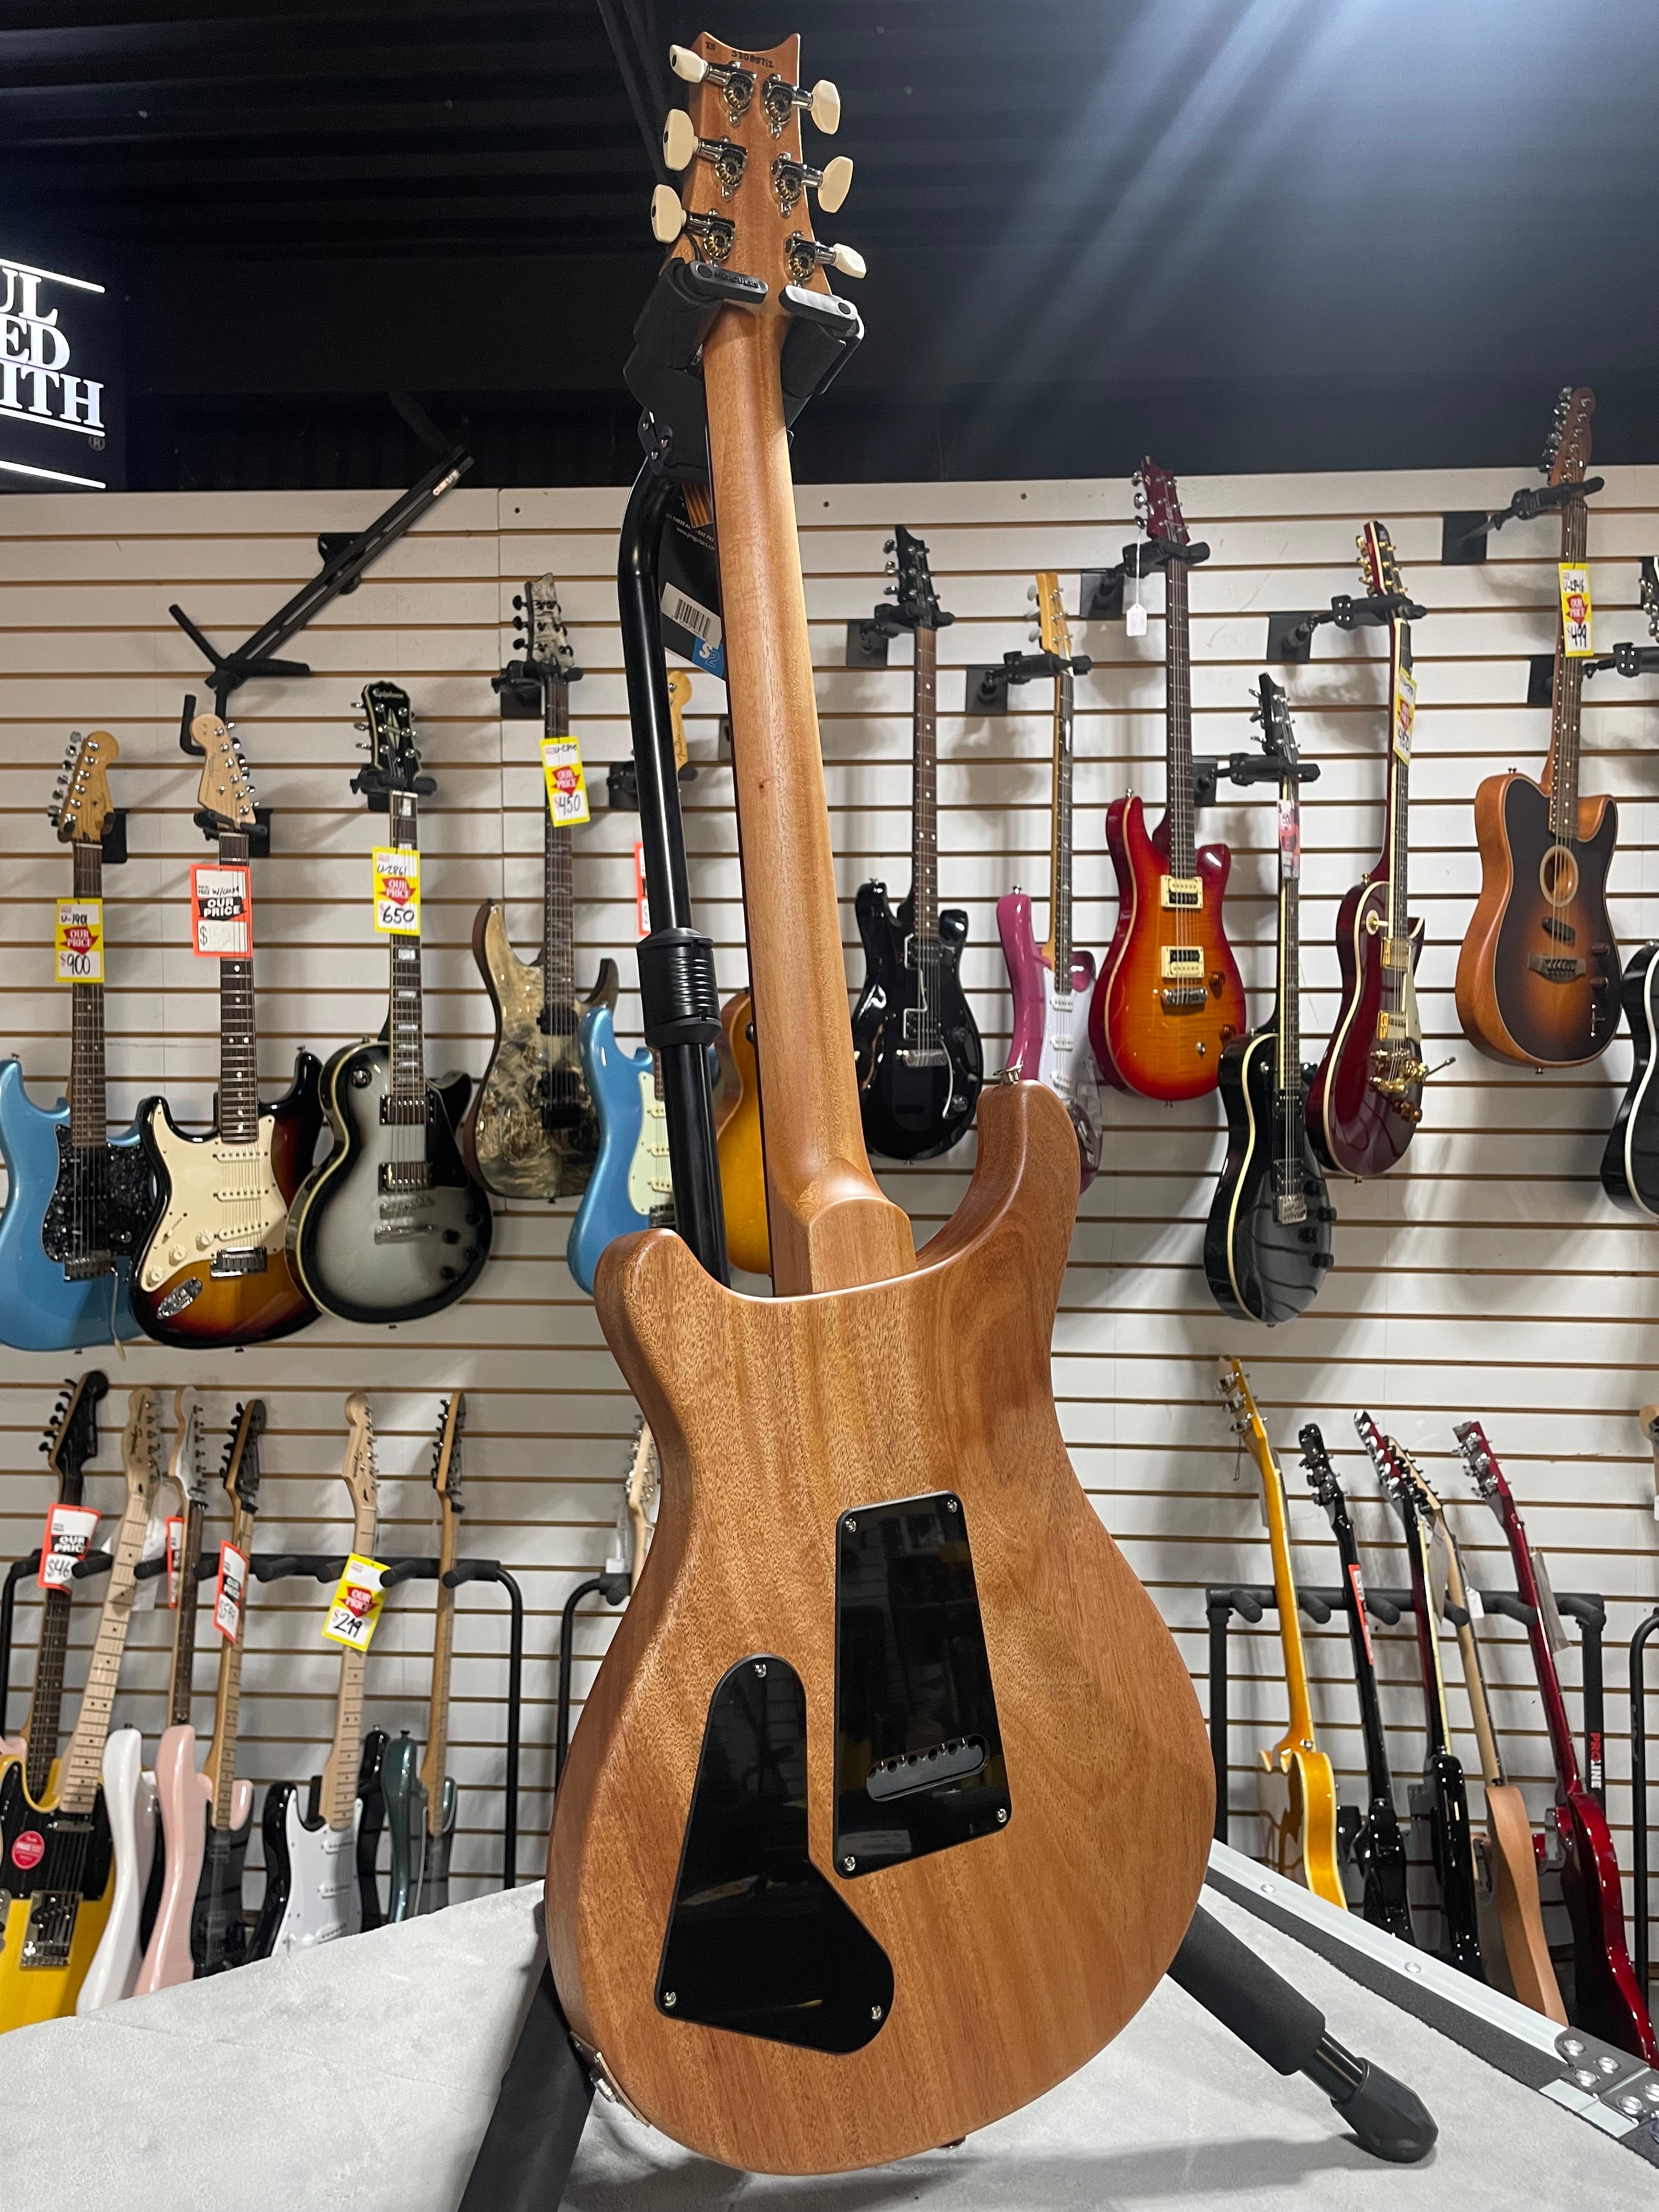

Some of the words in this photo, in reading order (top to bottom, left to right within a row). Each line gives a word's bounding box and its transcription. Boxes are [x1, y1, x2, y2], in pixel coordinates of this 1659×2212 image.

[388, 879, 408, 889] OUR
[386, 888, 410, 899] PRICE
[207, 898, 234, 909] OUR
[203, 905, 241, 918] PRICE
[70, 929, 89, 938] OUR
[67, 937, 93, 949] PRICE
[59, 1536, 86, 1545] OUR
[54, 1542, 84, 1553] PRIC
[351, 1589, 371, 1604] OUR
